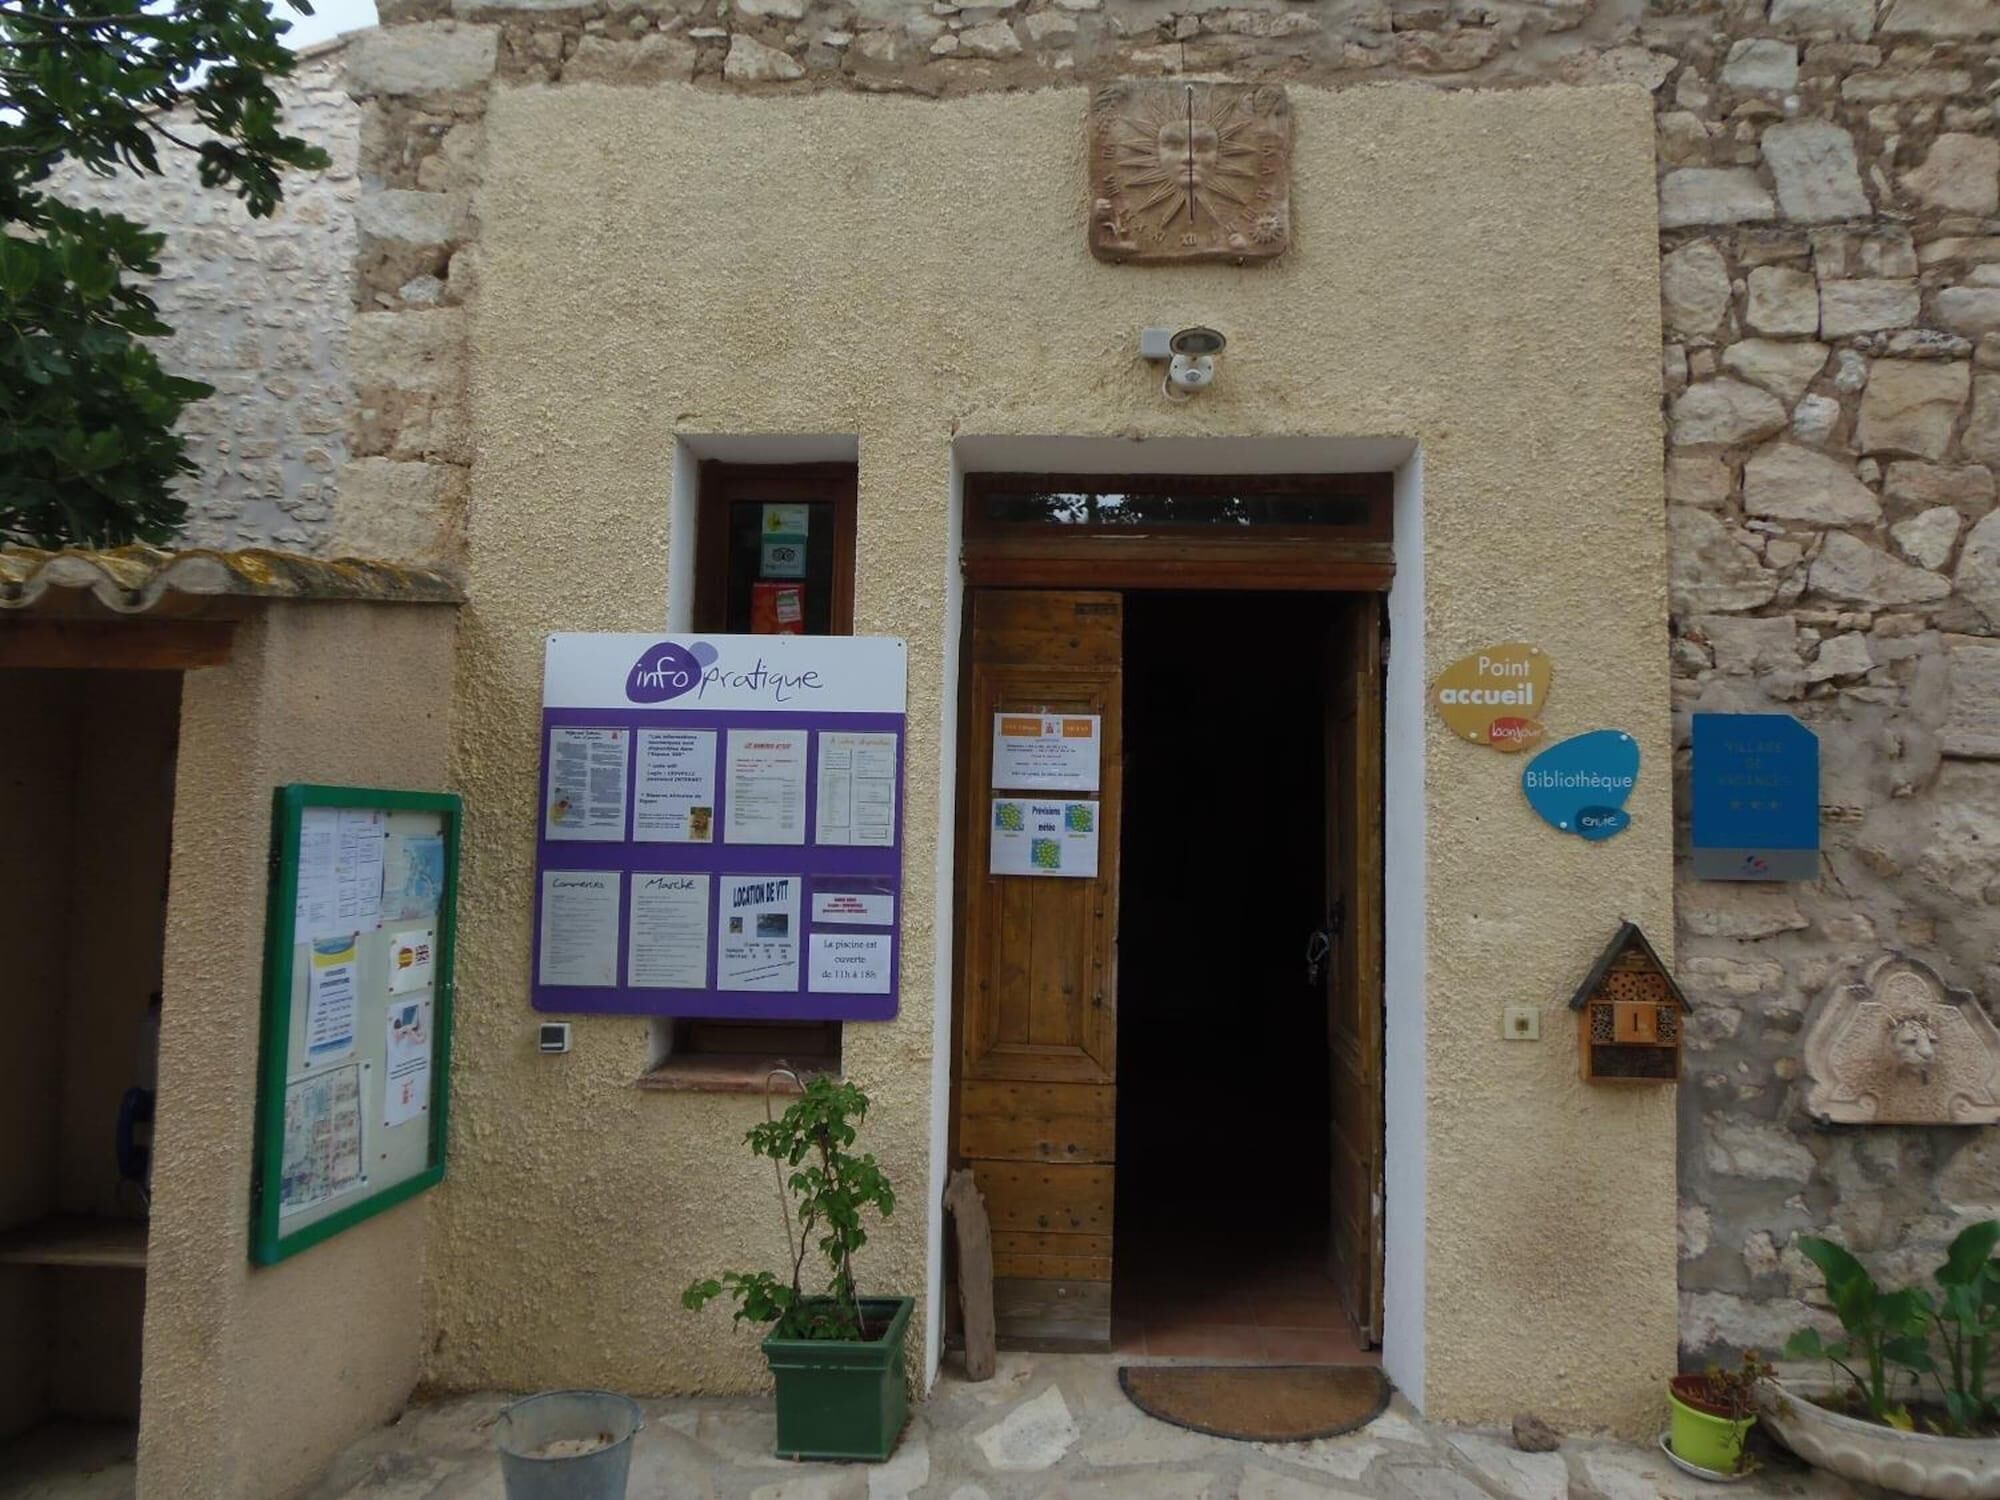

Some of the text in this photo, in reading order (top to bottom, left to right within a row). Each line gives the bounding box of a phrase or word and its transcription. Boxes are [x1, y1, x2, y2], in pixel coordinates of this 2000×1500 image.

[1478, 656, 1530, 677] Point
[636, 656, 823, 702] info pratique
[1439, 682, 1534, 705] accueil
[1492, 722, 1541, 743] bonjour
[1527, 771, 1633, 792] Bibliothèque
[733, 879, 789, 908] LOCATION DE VTT
[823, 939, 833, 949] La
[833, 956, 866, 964] ouverte
